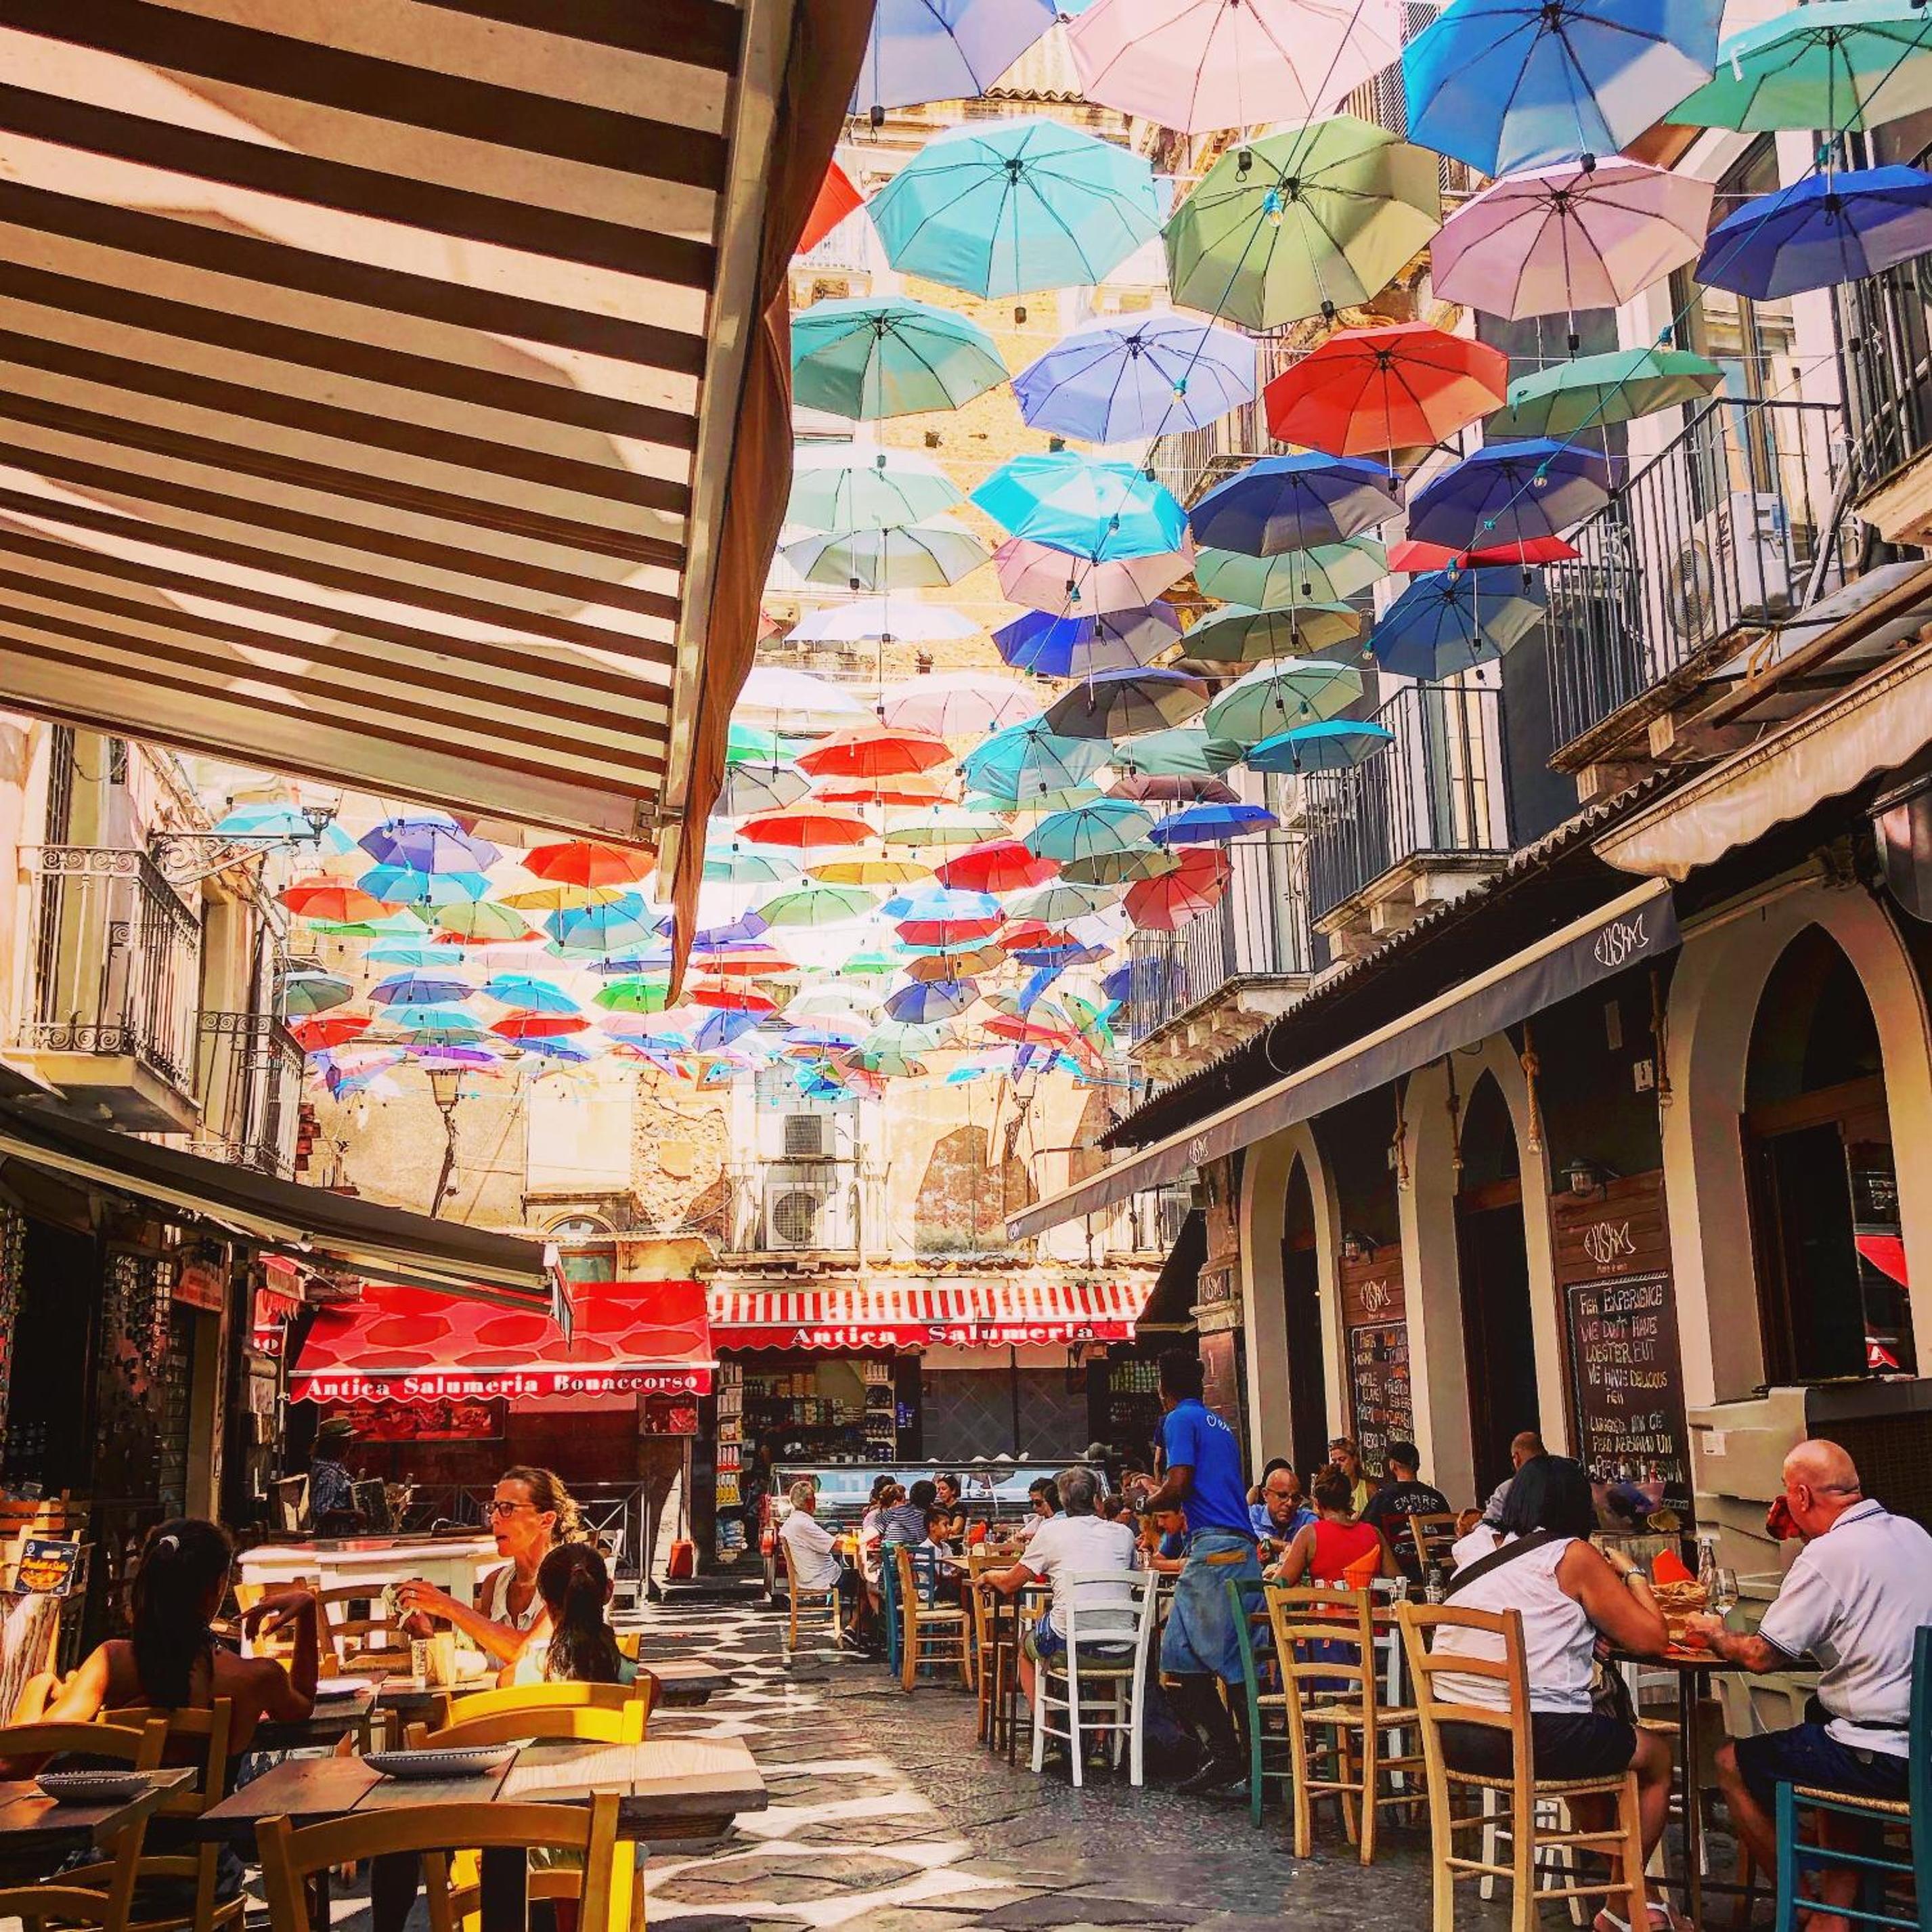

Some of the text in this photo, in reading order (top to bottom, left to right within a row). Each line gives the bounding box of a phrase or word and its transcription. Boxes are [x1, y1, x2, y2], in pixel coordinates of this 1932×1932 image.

[791, 1323, 1093, 1344] Antica Salumeria
[306, 1375, 697, 1396] Antica Salumeria Bonaccorso
